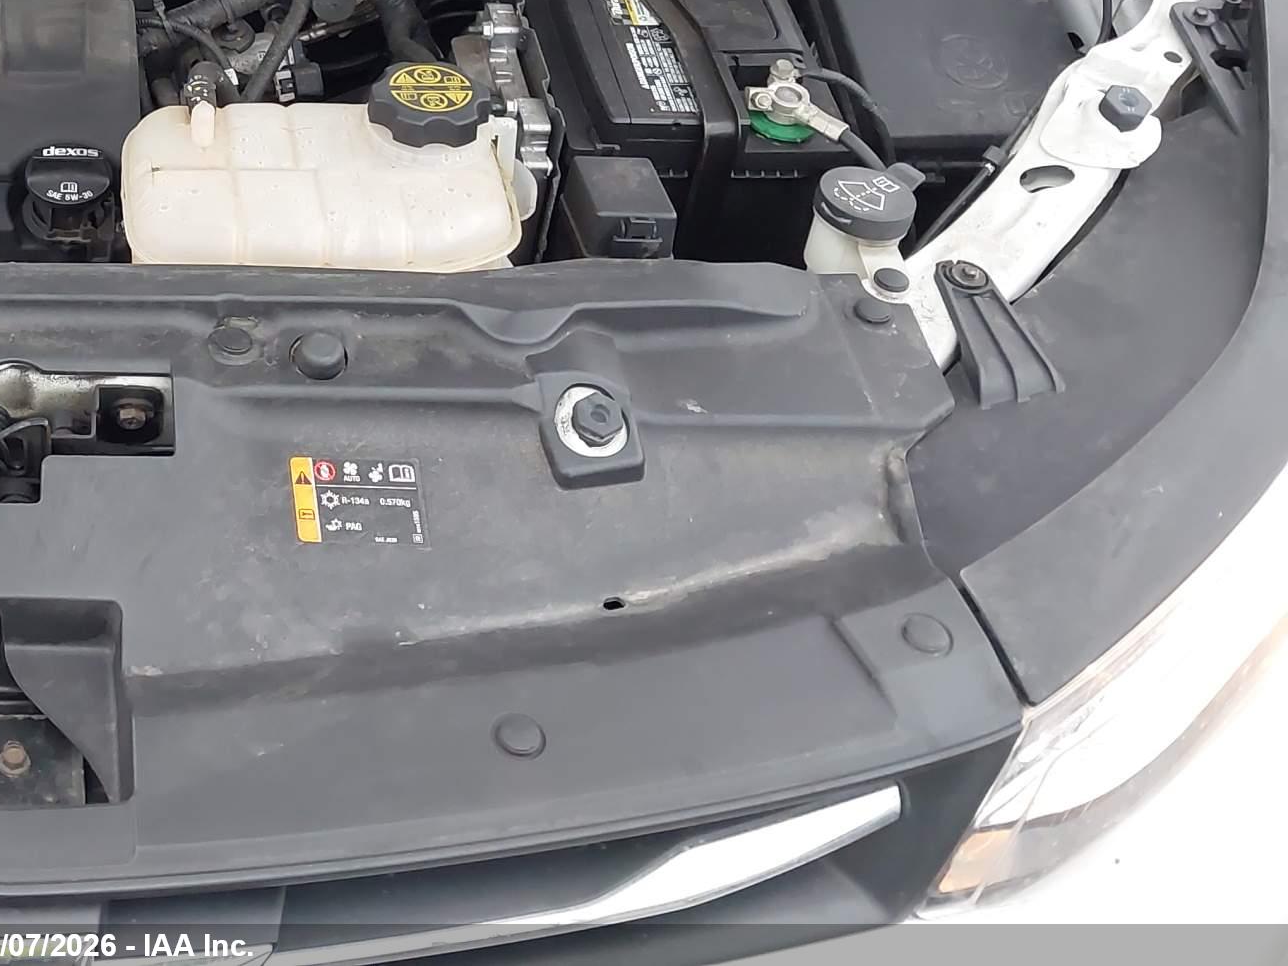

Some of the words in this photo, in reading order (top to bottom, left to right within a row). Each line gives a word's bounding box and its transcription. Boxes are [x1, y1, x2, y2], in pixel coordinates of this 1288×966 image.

[42, 146, 99, 157] dexos
[46, 190, 63, 201] SAE
[65, 190, 93, 201] 5W-30
[341, 496, 370, 506] R-134a
